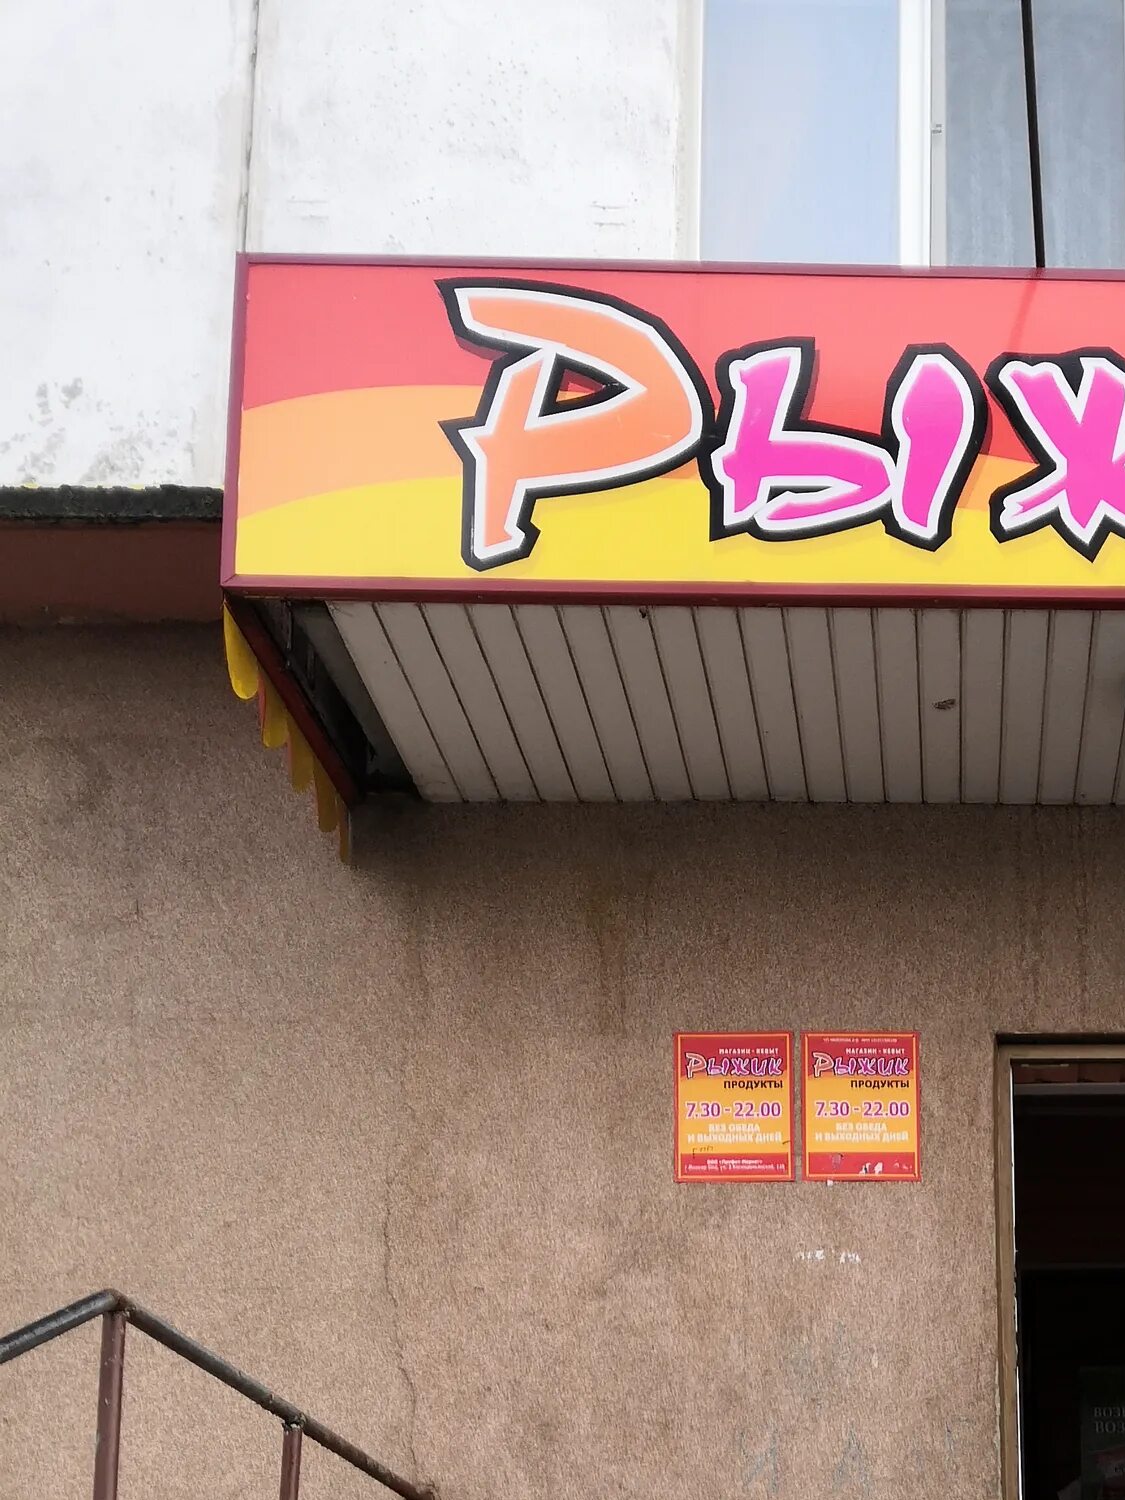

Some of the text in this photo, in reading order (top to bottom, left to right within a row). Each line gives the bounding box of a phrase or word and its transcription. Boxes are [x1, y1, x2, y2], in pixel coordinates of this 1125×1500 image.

[723, 1080, 783, 1090] ПРОДУКТЫ
[850, 1079, 909, 1089] ПРОДУКТЫ
[686, 1101, 721, 1119] 7.30
[733, 1101, 782, 1119] 22.00
[815, 1100, 850, 1118] 7.30
[862, 1100, 910, 1118] 22.00
[708, 1123, 760, 1133] БЕЗ ОБЕДА
[835, 1122, 887, 1132] БЕЗ ОБЕДА
[687, 1132, 782, 1144] И ВЫХОДНЫХ ДНЕЙ
[815, 1131, 909, 1143] И ВЫХОДНЫХ ДНЕЙ
